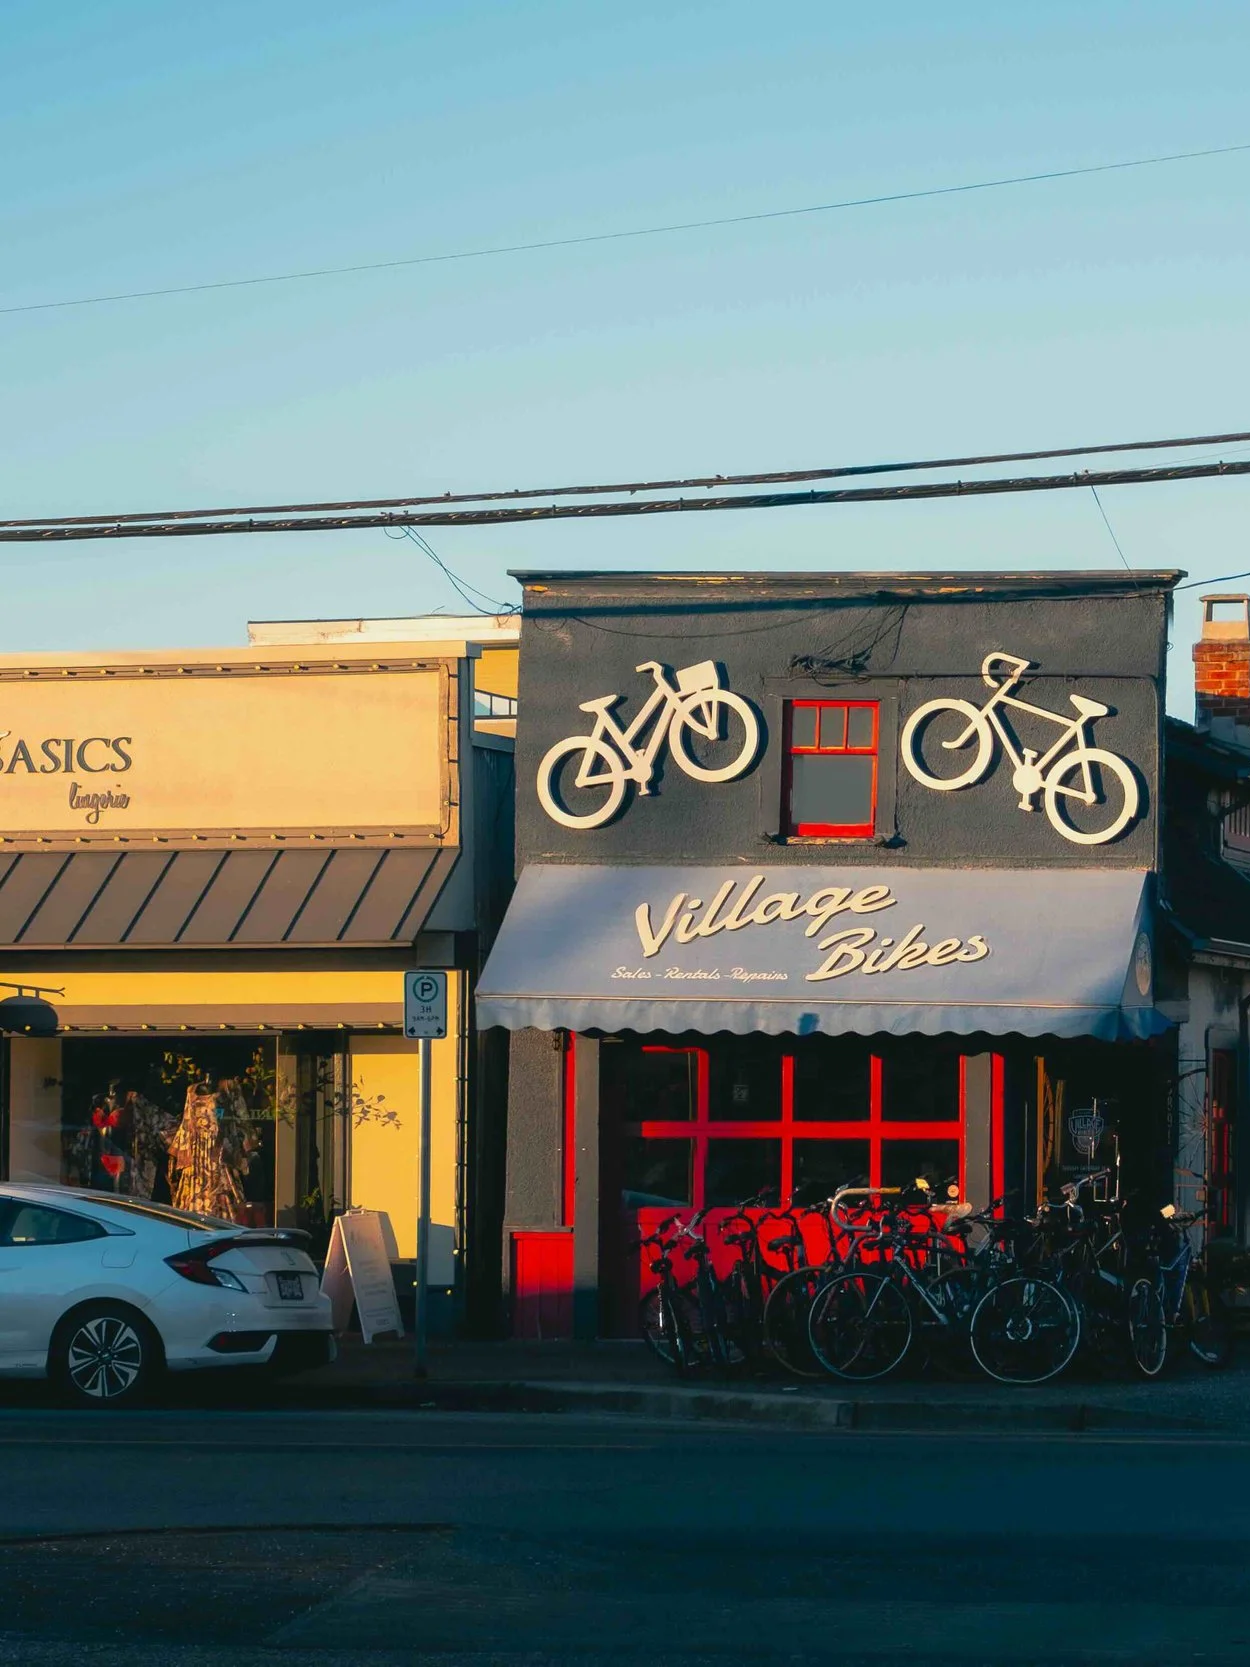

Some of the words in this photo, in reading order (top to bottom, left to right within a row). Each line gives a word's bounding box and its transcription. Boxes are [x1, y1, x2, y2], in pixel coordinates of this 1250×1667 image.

[0, 737, 132, 773] ASICS
[635, 875, 898, 958] Village
[805, 924, 991, 982] Bikes
[421, 982, 432, 996] P
[611, 966, 651, 979] Sales
[664, 966, 720, 980] Rentals
[730, 967, 788, 983] Repairs
